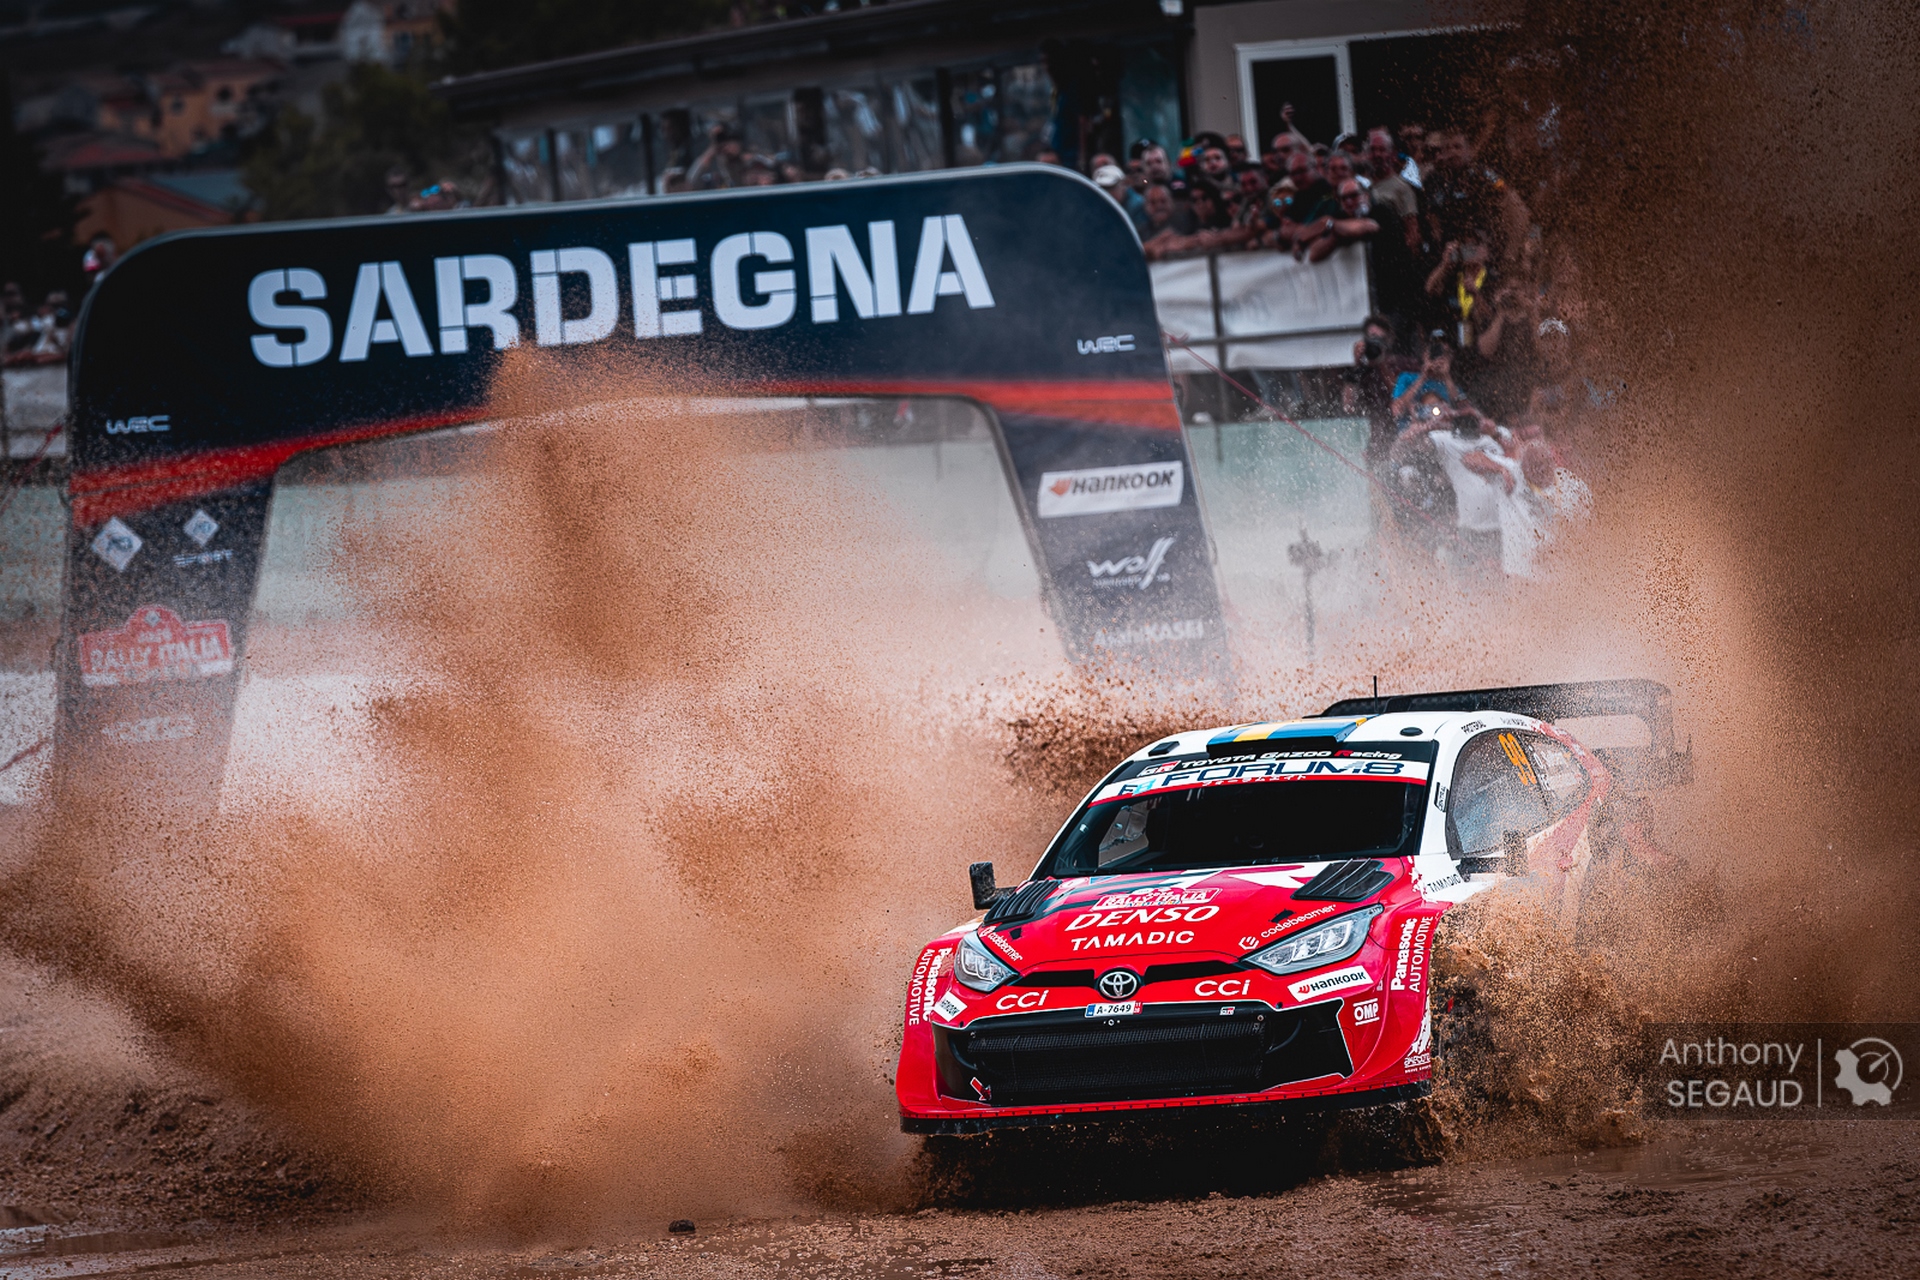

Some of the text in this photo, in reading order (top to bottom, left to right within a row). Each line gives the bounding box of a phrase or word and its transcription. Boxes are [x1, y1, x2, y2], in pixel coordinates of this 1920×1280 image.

[247, 214, 995, 368] SARDEGNA
[1180, 754, 1256, 768] TOYOTA
[1259, 750, 1332, 761] GAZOO
[1334, 749, 1403, 760] Racing
[1161, 761, 1405, 787] FORUM8
[1064, 905, 1220, 931] DENSO
[1071, 930, 1195, 951] TAMADIC
[1390, 917, 1418, 991] Panasonic
[1409, 916, 1434, 993] AUTOMOTIVE
[908, 949, 935, 1026] AUTOMOTIVE
[1096, 1003, 1132, 1015] A-7649
[1354, 1001, 1380, 1021] OMP
